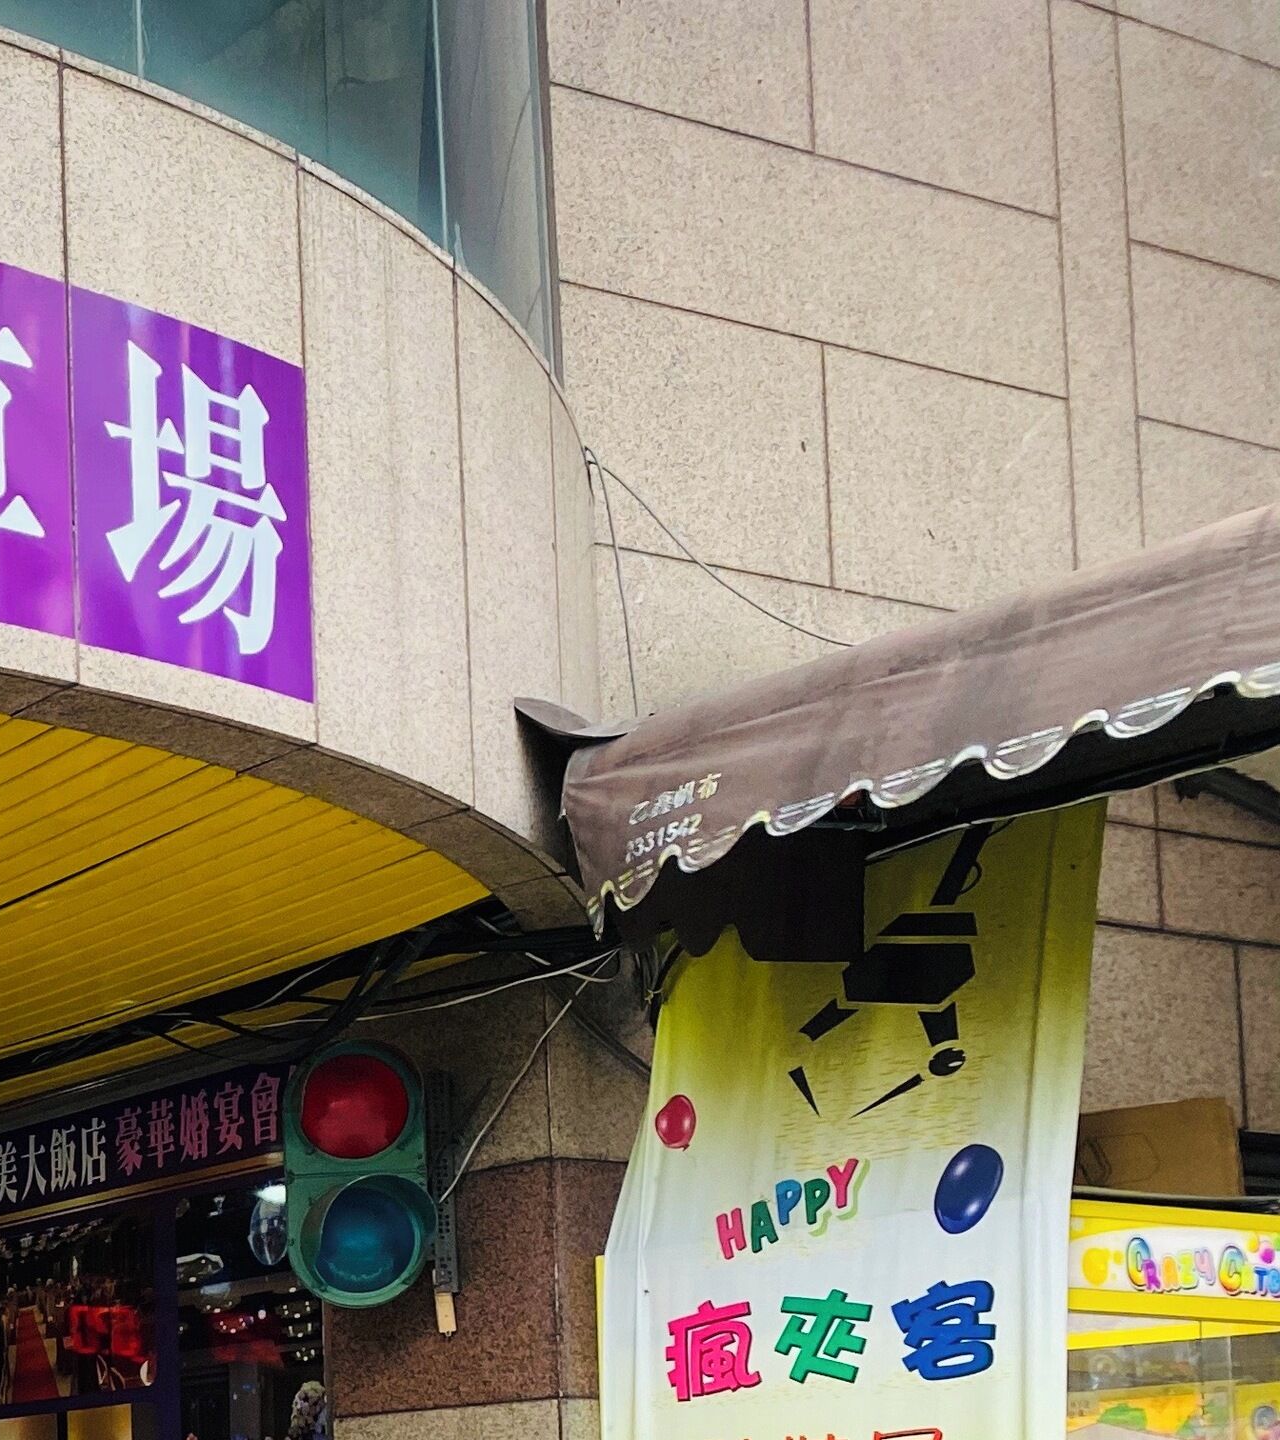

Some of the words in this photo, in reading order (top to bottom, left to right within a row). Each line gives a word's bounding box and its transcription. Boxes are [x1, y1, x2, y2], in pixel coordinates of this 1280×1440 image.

[115, 1065, 298, 1176] 豪華婚宴會
[716, 1157, 860, 1261] HAPPY
